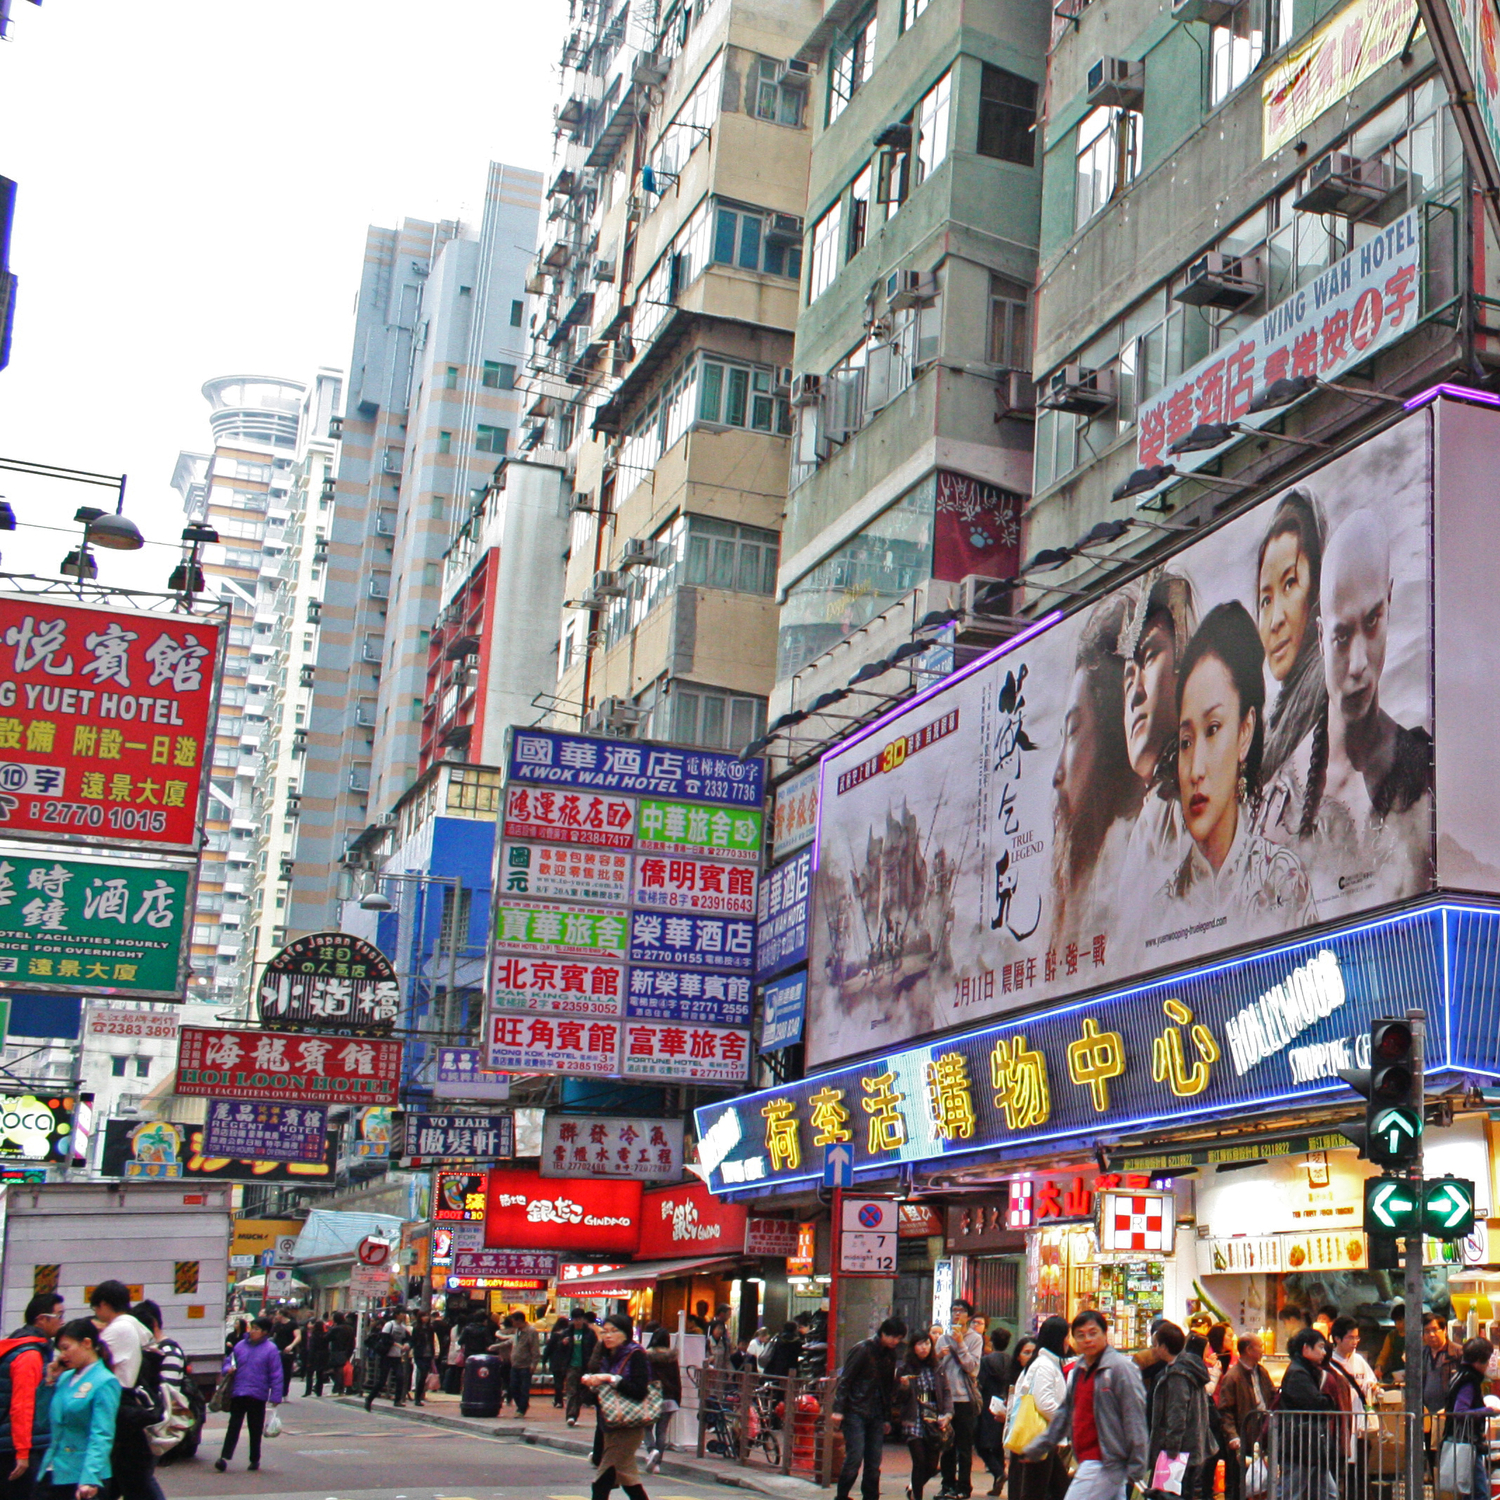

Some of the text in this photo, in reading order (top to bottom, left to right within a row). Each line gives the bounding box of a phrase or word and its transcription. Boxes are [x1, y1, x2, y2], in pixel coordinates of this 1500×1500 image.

[1263, 214, 1416, 346] WING WAH HOTEL
[25, 684, 183, 726] YUET HOTEL
[72, 725, 197, 768] 附設一日遊
[516, 736, 684, 779] 國華酒店
[883, 736, 906, 773] 3D
[80, 771, 189, 808] 遠景大廈
[519, 765, 678, 793] KWOK WAH HOTEL
[705, 780, 755, 801] 2332 7736
[109, 808, 166, 832] 1015
[613, 805, 626, 825] 7
[641, 803, 750, 846] 中華旅舍 3
[1011, 841, 1044, 864] LEGEND
[1012, 830, 1034, 848] TRUE
[641, 858, 754, 897] 僑明賓館
[83, 878, 175, 928] 酒店
[701, 895, 752, 912] 23916643
[37, 933, 169, 949] FACILITIES HOURLY
[502, 910, 624, 948] 寶華旅舍
[633, 914, 753, 953] 榮華酒店
[35, 945, 144, 959] FOR OVERNIGHT
[355, 940, 391, 977] fusion
[644, 950, 702, 963] 2770 0155
[28, 958, 138, 981] 遠景大廈
[498, 959, 619, 996] 北京賓館
[261, 973, 399, 1021] 水道橋
[531, 992, 568, 1000] KING
[574, 995, 617, 1003] VILLA
[631, 969, 750, 1002] 新榮華賓館
[954, 970, 994, 1008] 2月11日
[692, 1001, 749, 1014] 2771 2556
[1226, 949, 1346, 1076] HOLLYWOOD
[108, 1022, 176, 1037] 2383 3891
[494, 1017, 617, 1053] 旺角賓館
[629, 1025, 746, 1061] 富華旅舍
[206, 1034, 376, 1076] 海龍賓館
[674, 1059, 703, 1067] HOTEL
[179, 1086, 357, 1101] HOTEL OVER NIGHT LESS
[180, 1069, 395, 1094] HOI LOON HOTEL
[212, 1120, 320, 1135] REGENT HOTEL
[430, 1117, 490, 1127] VO HAIR
[419, 1129, 498, 1155] 傲髮軒
[439, 1211, 463, 1220] FOOT
[526, 1197, 630, 1226] 銀だこ GINDACO
[877, 1235, 886, 1248] 7
[844, 1253, 892, 1270] midnight 12
